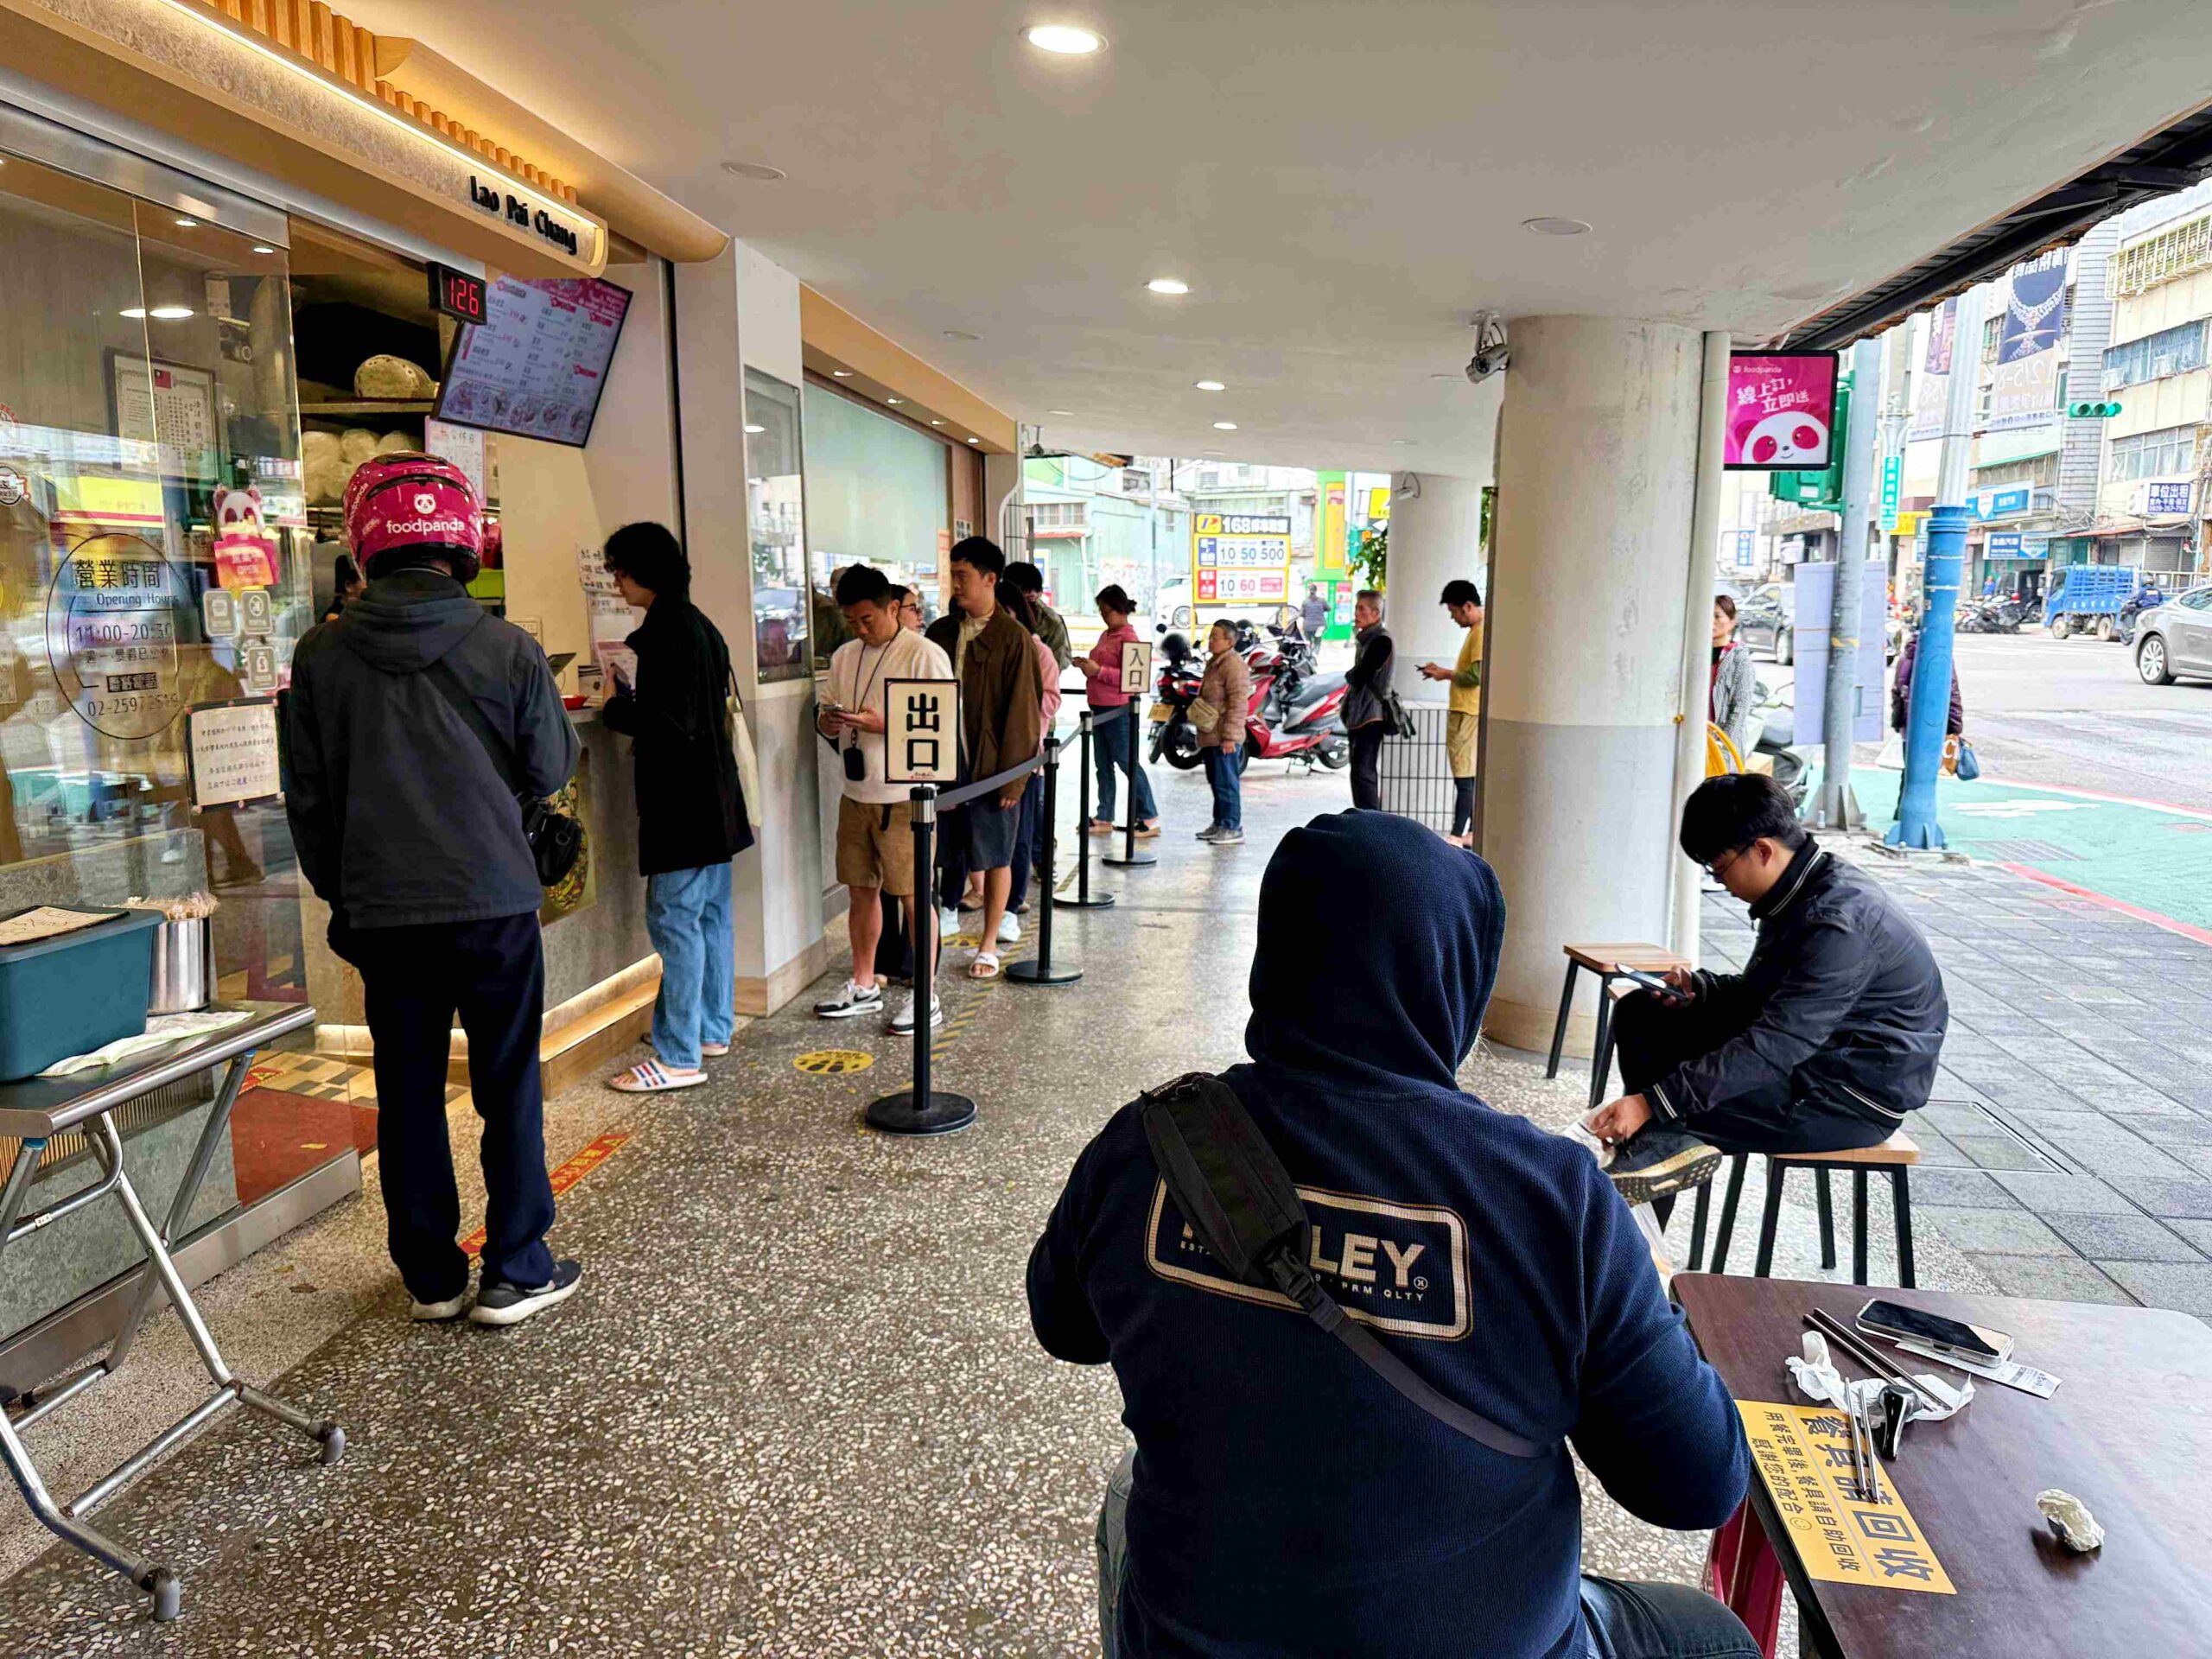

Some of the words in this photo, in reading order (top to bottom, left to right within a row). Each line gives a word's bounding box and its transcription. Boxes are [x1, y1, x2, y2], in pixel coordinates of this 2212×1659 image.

[470, 175, 500, 212] Lao
[505, 194, 530, 226] Pai
[534, 209, 577, 256] Chang
[450, 276, 479, 316] 126
[1744, 365, 1782, 374] foodpanda
[1761, 389, 1809, 415] 立即送
[385, 518, 465, 536] foodpanda
[1221, 547, 1236, 560] 10
[1241, 548, 1257, 560] 50
[1261, 548, 1285, 560] 500
[72, 559, 162, 590] 營業時間
[1220, 579, 1235, 592] 10
[1240, 579, 1255, 591] 60
[96, 593, 142, 607] Opening
[147, 594, 179, 605] Hours
[1128, 648, 1144, 687] 入口
[906, 693, 939, 771] 出口
[1342, 1281, 1372, 1294] PRM
[1383, 1288, 1424, 1301] QLTY
[1751, 1437, 1804, 1515] 感謝您的配合
[1800, 1414, 1935, 1582] 餐具請回收
